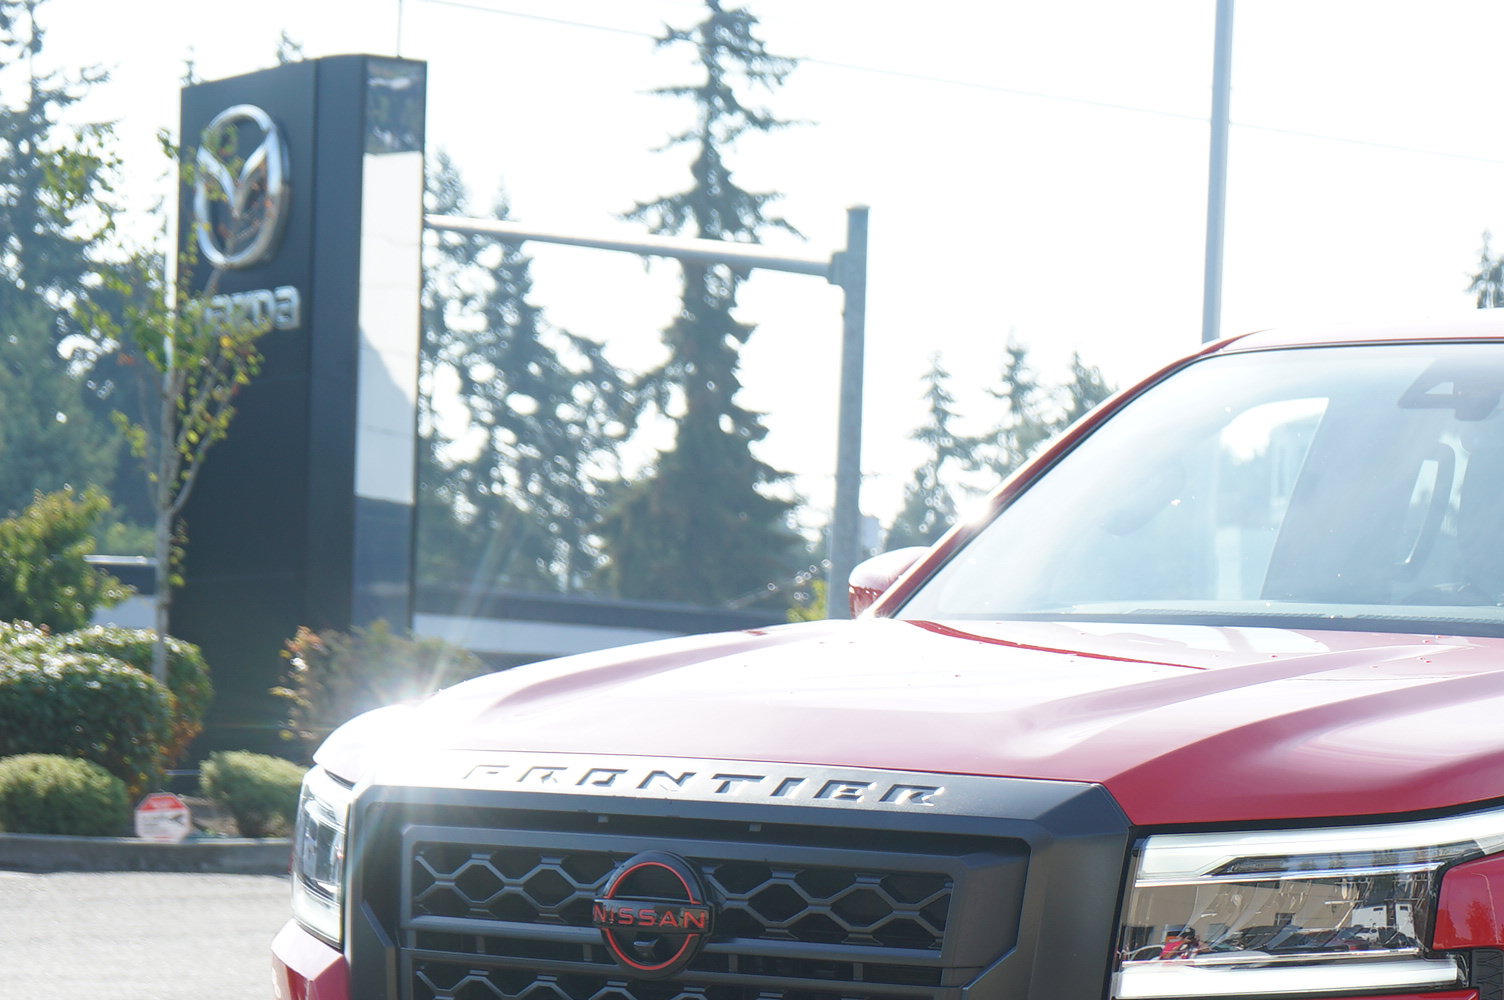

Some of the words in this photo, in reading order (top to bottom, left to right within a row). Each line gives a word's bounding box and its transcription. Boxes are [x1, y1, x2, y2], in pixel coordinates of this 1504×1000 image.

[189, 285, 300, 333] azda
[461, 763, 946, 807] FRONTIER
[593, 903, 705, 928] NISSAN
